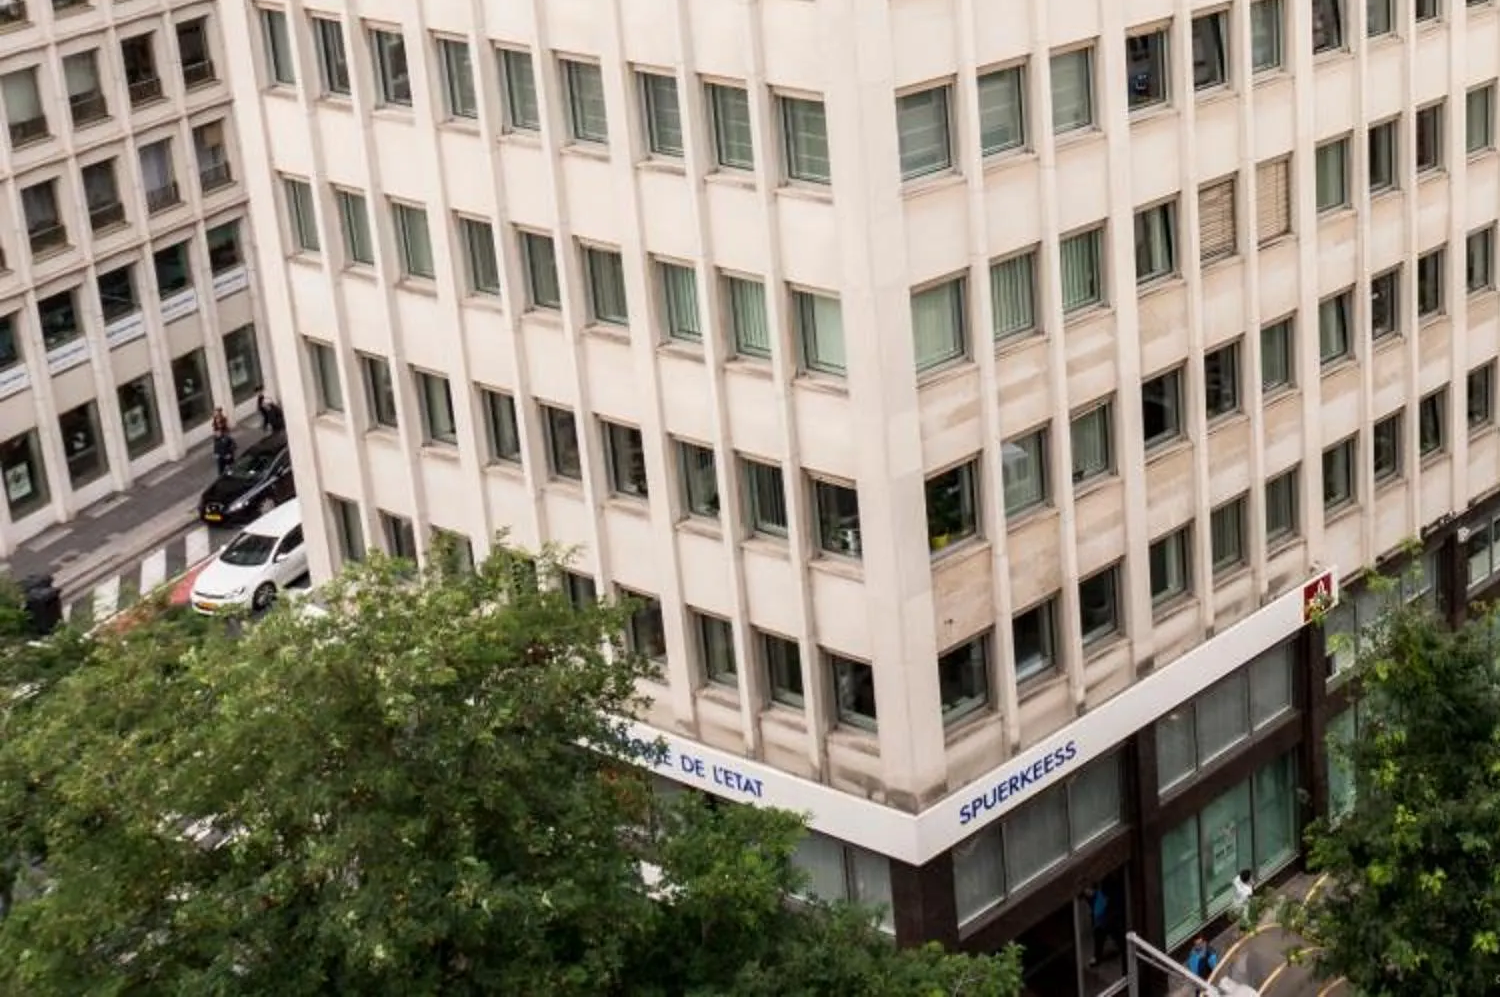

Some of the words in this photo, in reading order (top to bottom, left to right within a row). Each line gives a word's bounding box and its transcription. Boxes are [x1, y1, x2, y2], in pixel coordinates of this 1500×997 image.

[680, 754, 705, 778] DE
[712, 765, 764, 798] L'ETAT
[959, 740, 1077, 824] SPUERKEESS
